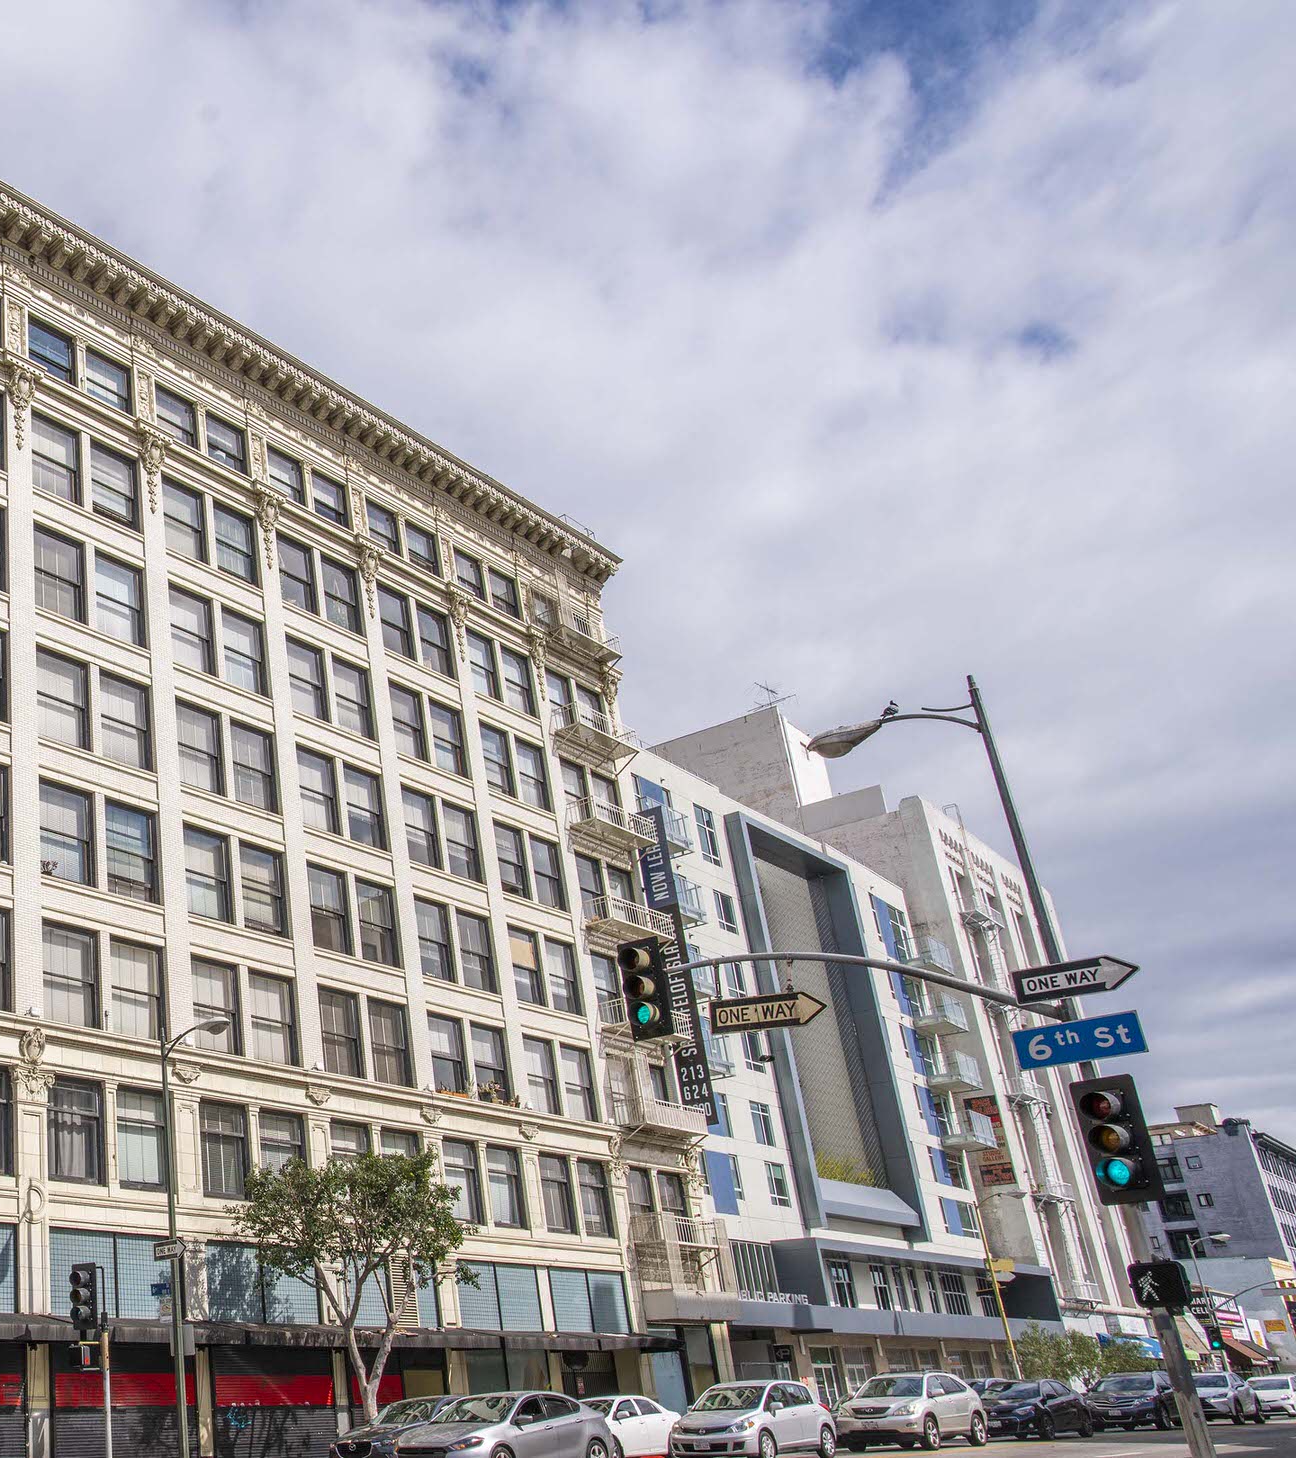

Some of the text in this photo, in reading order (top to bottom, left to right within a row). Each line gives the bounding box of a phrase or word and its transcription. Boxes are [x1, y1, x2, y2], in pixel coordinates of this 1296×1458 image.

[649, 871, 670, 901] NOW
[1026, 968, 1098, 992] ONE WAY
[718, 1002, 796, 1024] ONE WAY
[1028, 1024, 1132, 1061] 6th St
[680, 1064, 704, 1082] 213
[683, 1083, 709, 1101] 624
[156, 1247, 166, 1255] ONE
[767, 1292, 809, 1305] PARKING
